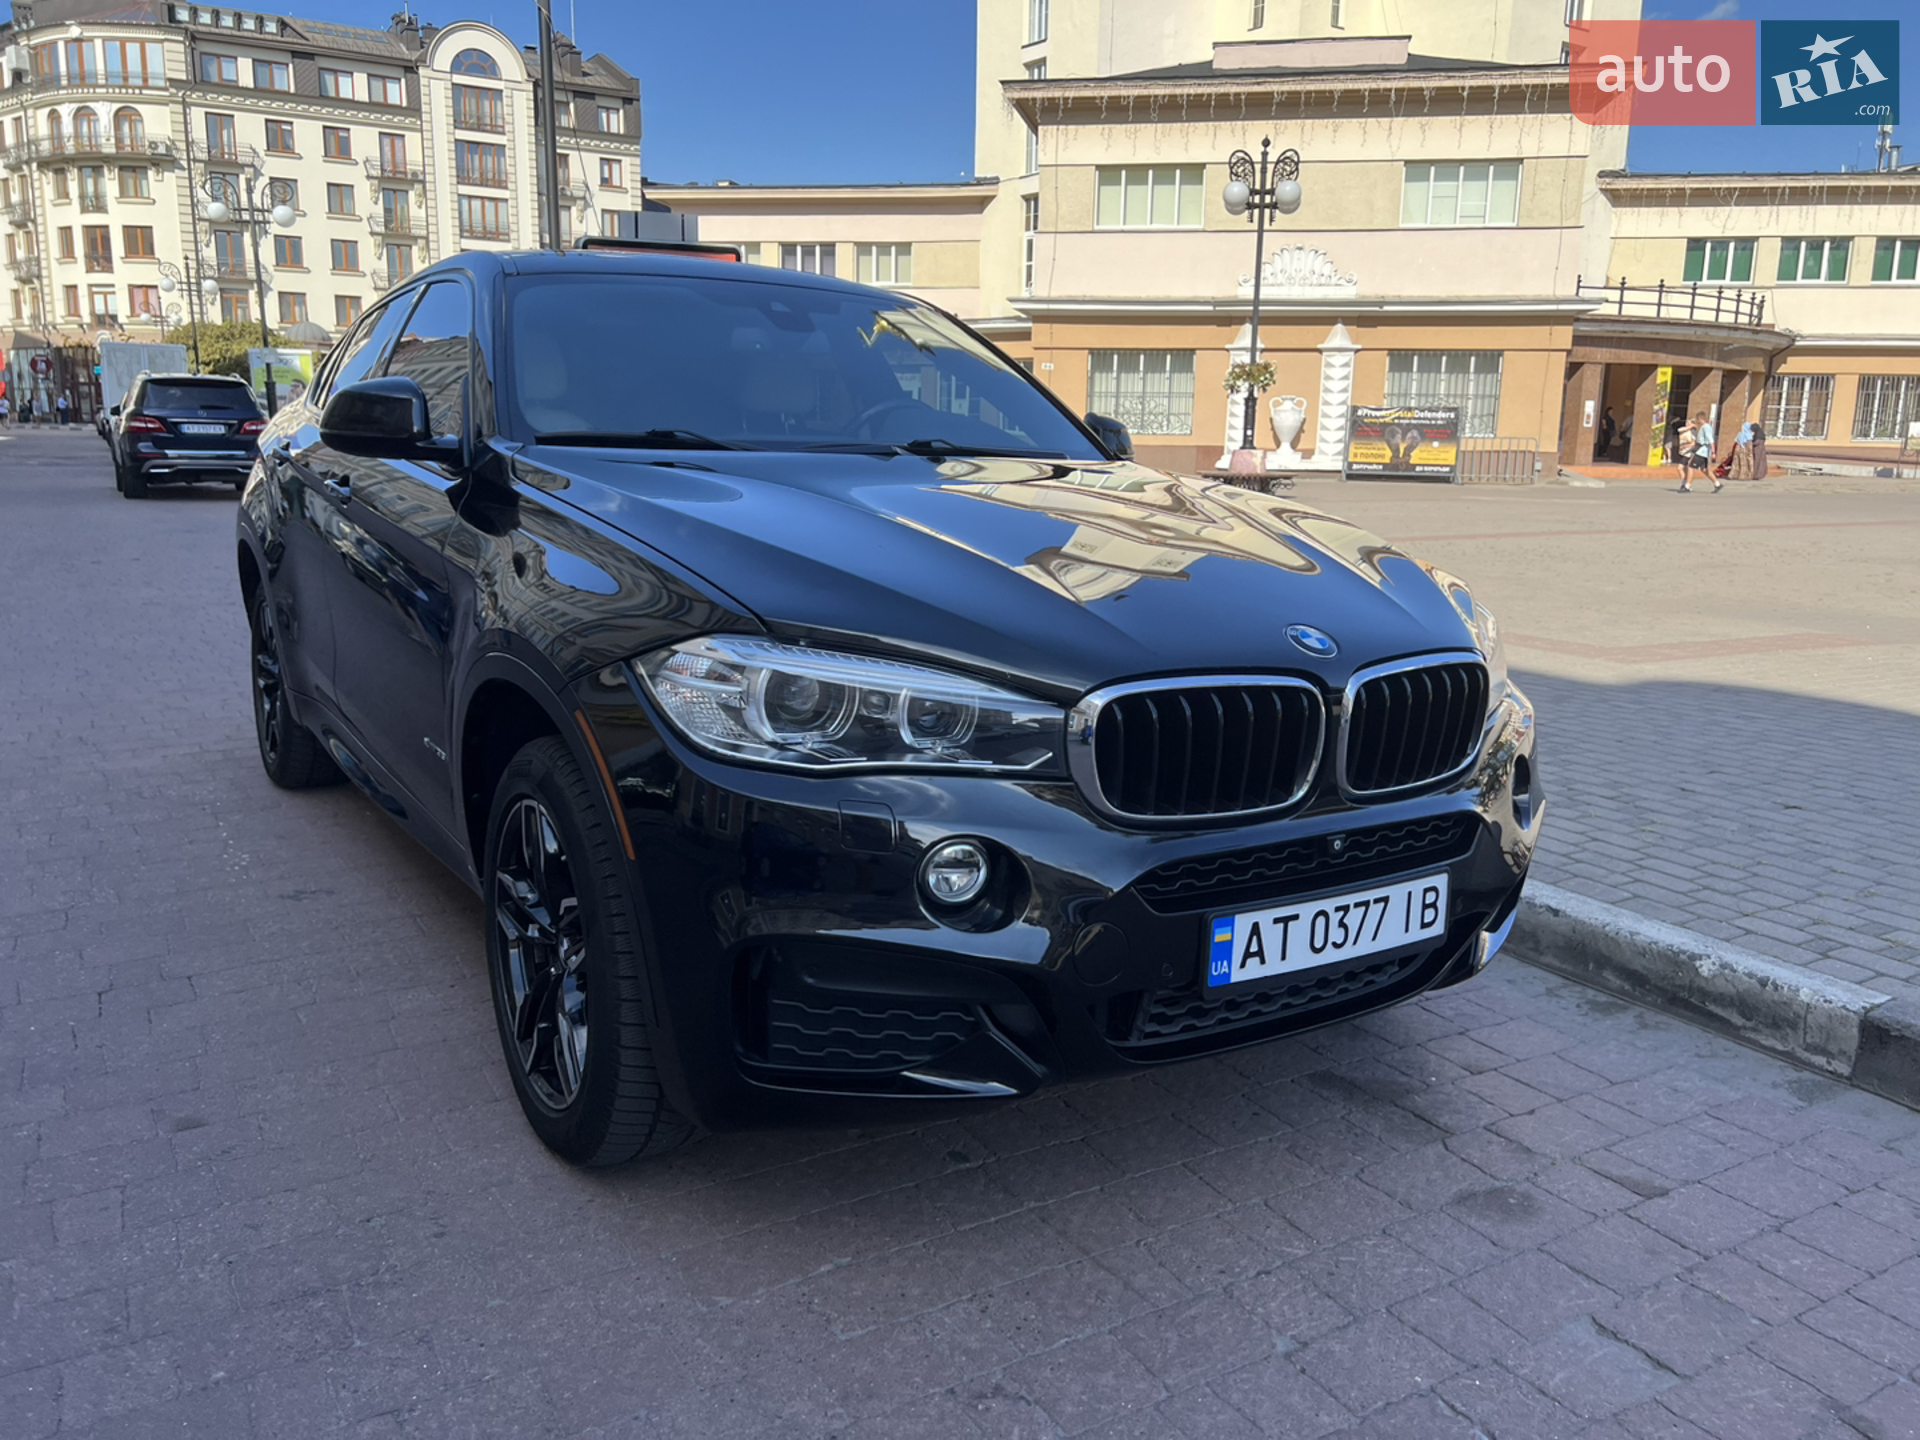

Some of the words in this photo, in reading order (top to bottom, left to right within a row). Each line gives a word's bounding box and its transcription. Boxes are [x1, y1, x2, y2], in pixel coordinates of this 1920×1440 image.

[1239, 913, 1300, 969] AT
[1309, 895, 1390, 954] 0377
[1404, 885, 1440, 934] IB
[1211, 959, 1229, 976] UA
